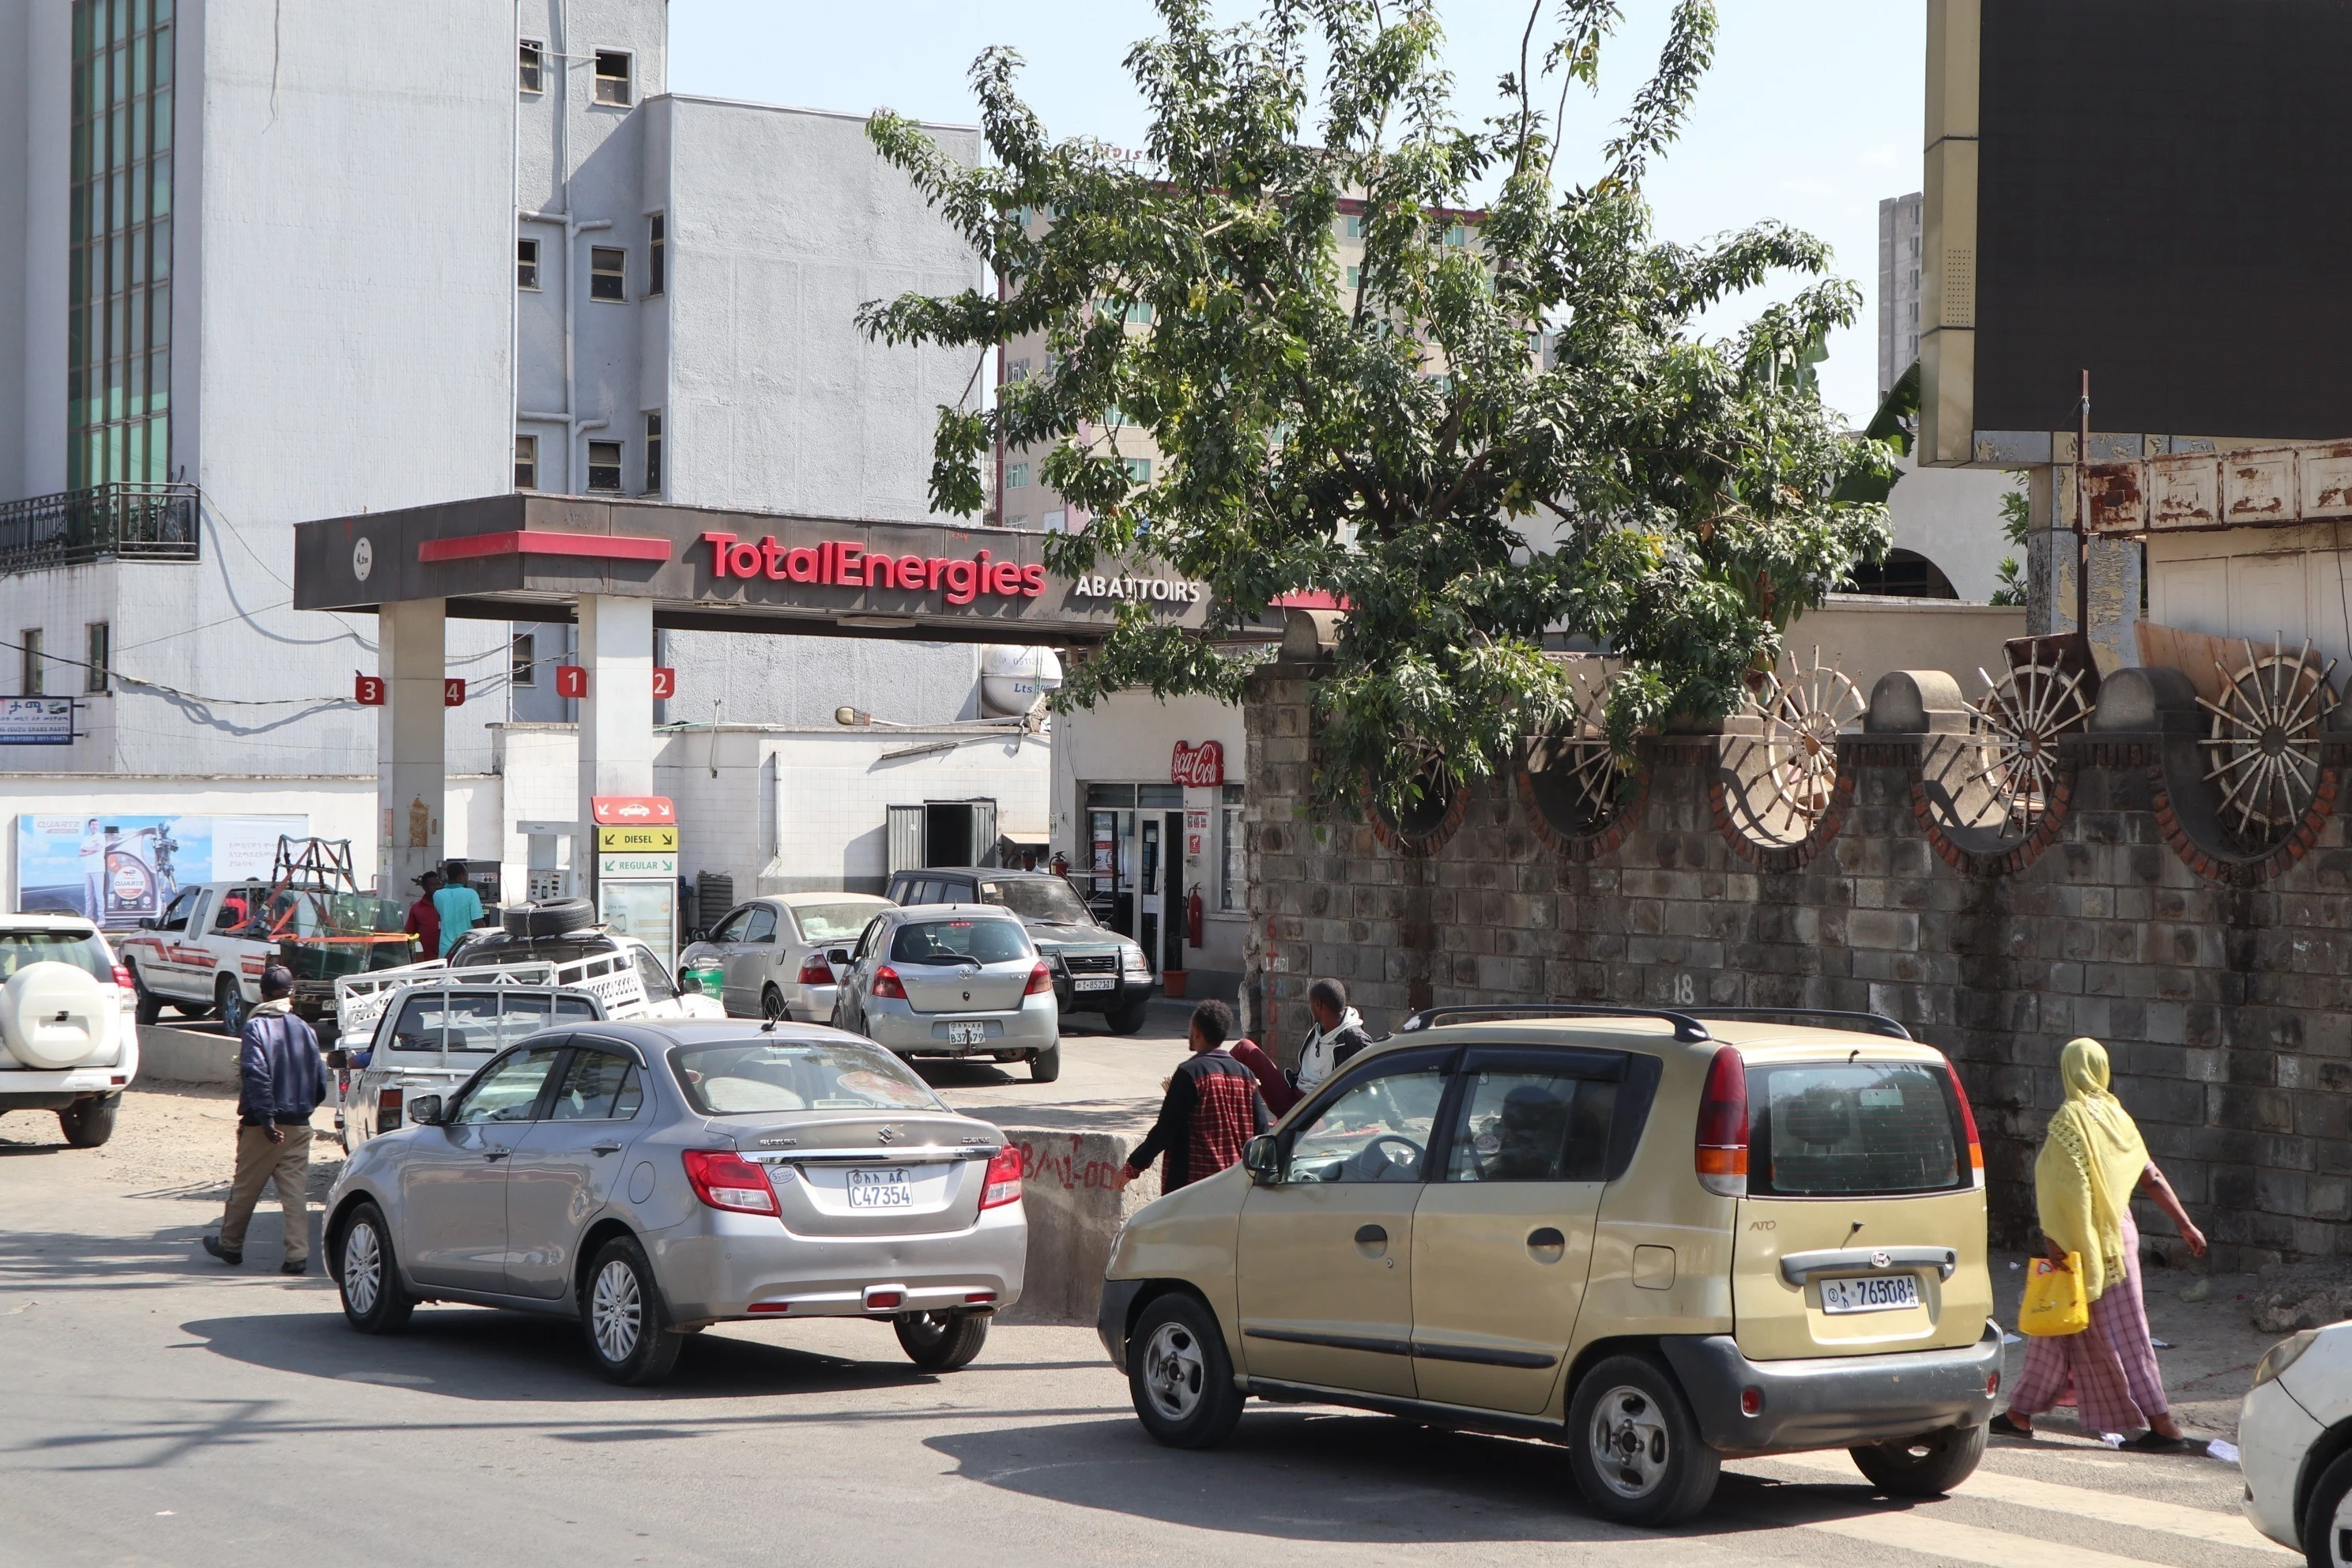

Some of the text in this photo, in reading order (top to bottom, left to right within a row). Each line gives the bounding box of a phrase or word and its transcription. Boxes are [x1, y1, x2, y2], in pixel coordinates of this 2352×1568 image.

[701, 532, 1200, 605] TotalEnergies ABATTOIRS
[364, 681, 376, 700] 3
[446, 683, 460, 702] 4
[568, 672, 578, 692] 1
[654, 673, 668, 694] 2
[1674, 973, 1694, 1004] 18
[951, 1033, 984, 1043] B3779
[852, 1185, 910, 1206] C47354
[1856, 1279, 1907, 1305] 76508
